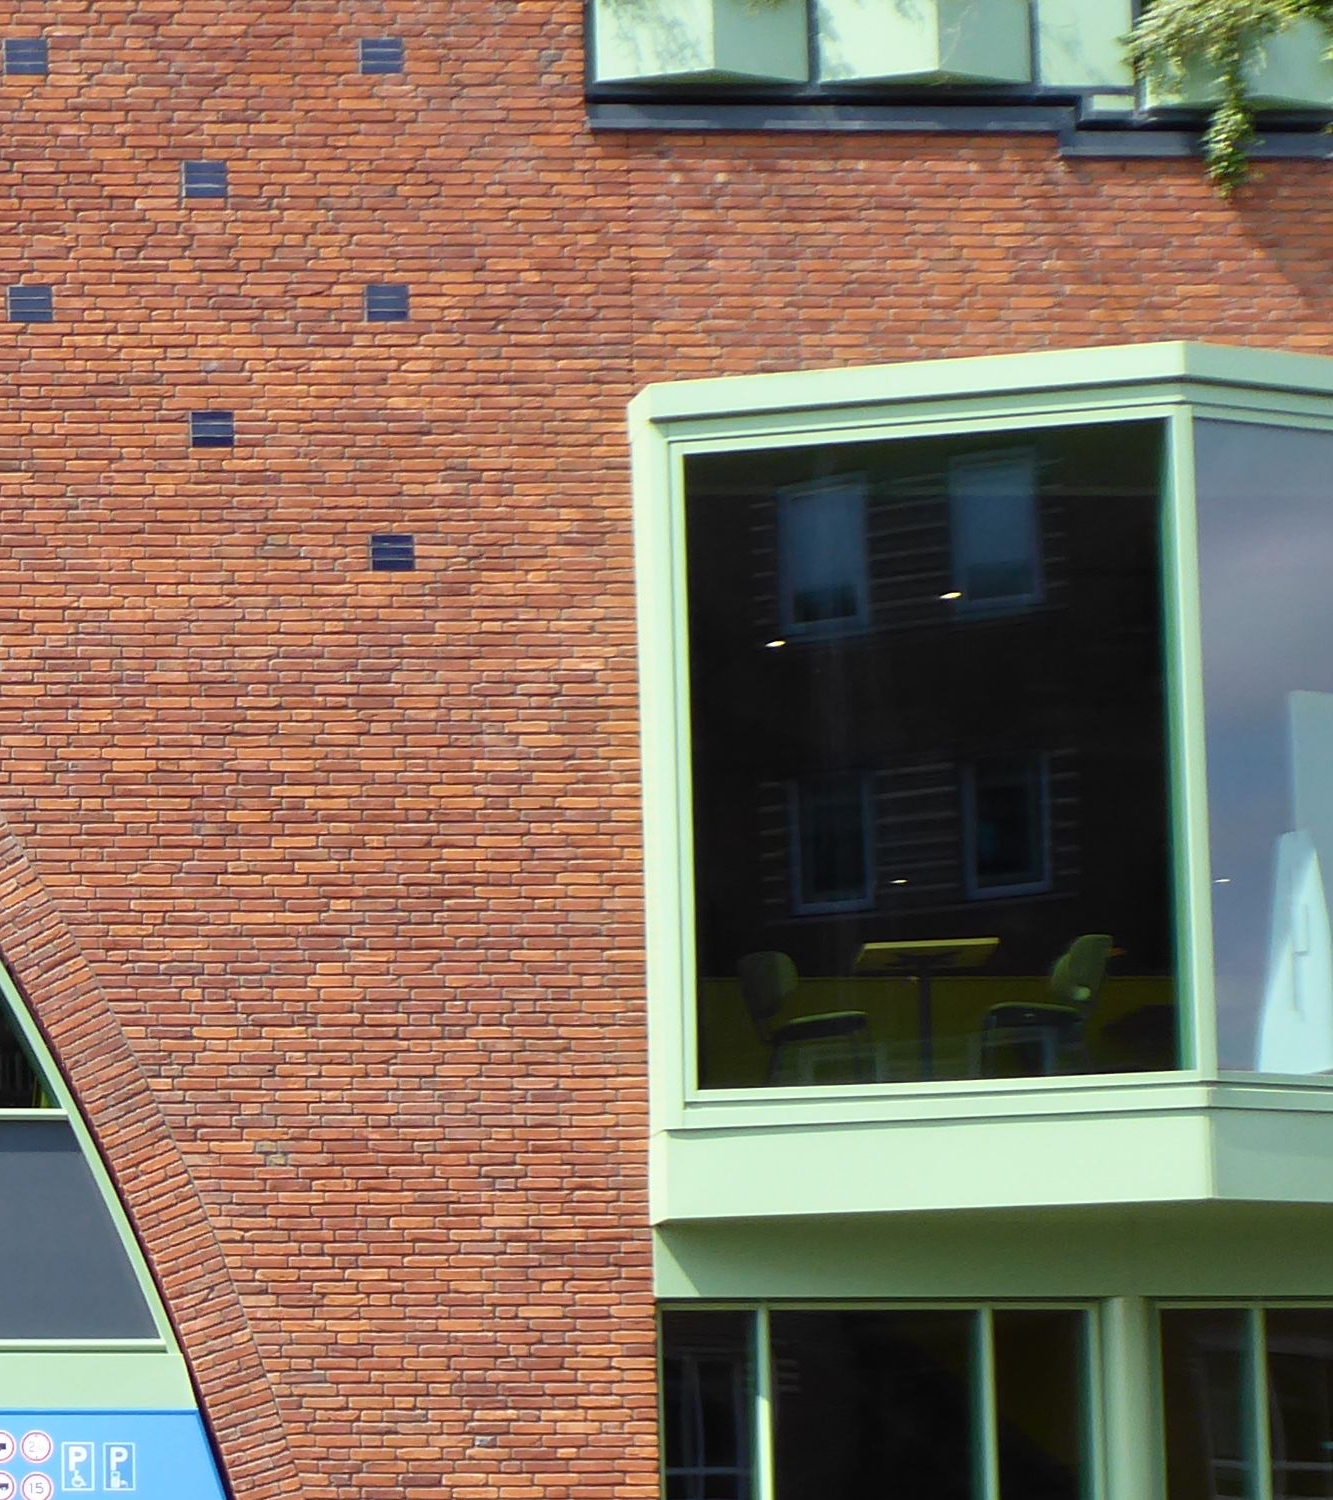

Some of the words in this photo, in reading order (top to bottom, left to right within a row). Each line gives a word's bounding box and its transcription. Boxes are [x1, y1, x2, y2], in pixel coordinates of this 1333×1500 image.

[68, 1446, 87, 1471] P
[109, 1446, 129, 1471] P
[28, 1482, 44, 1495] 15
